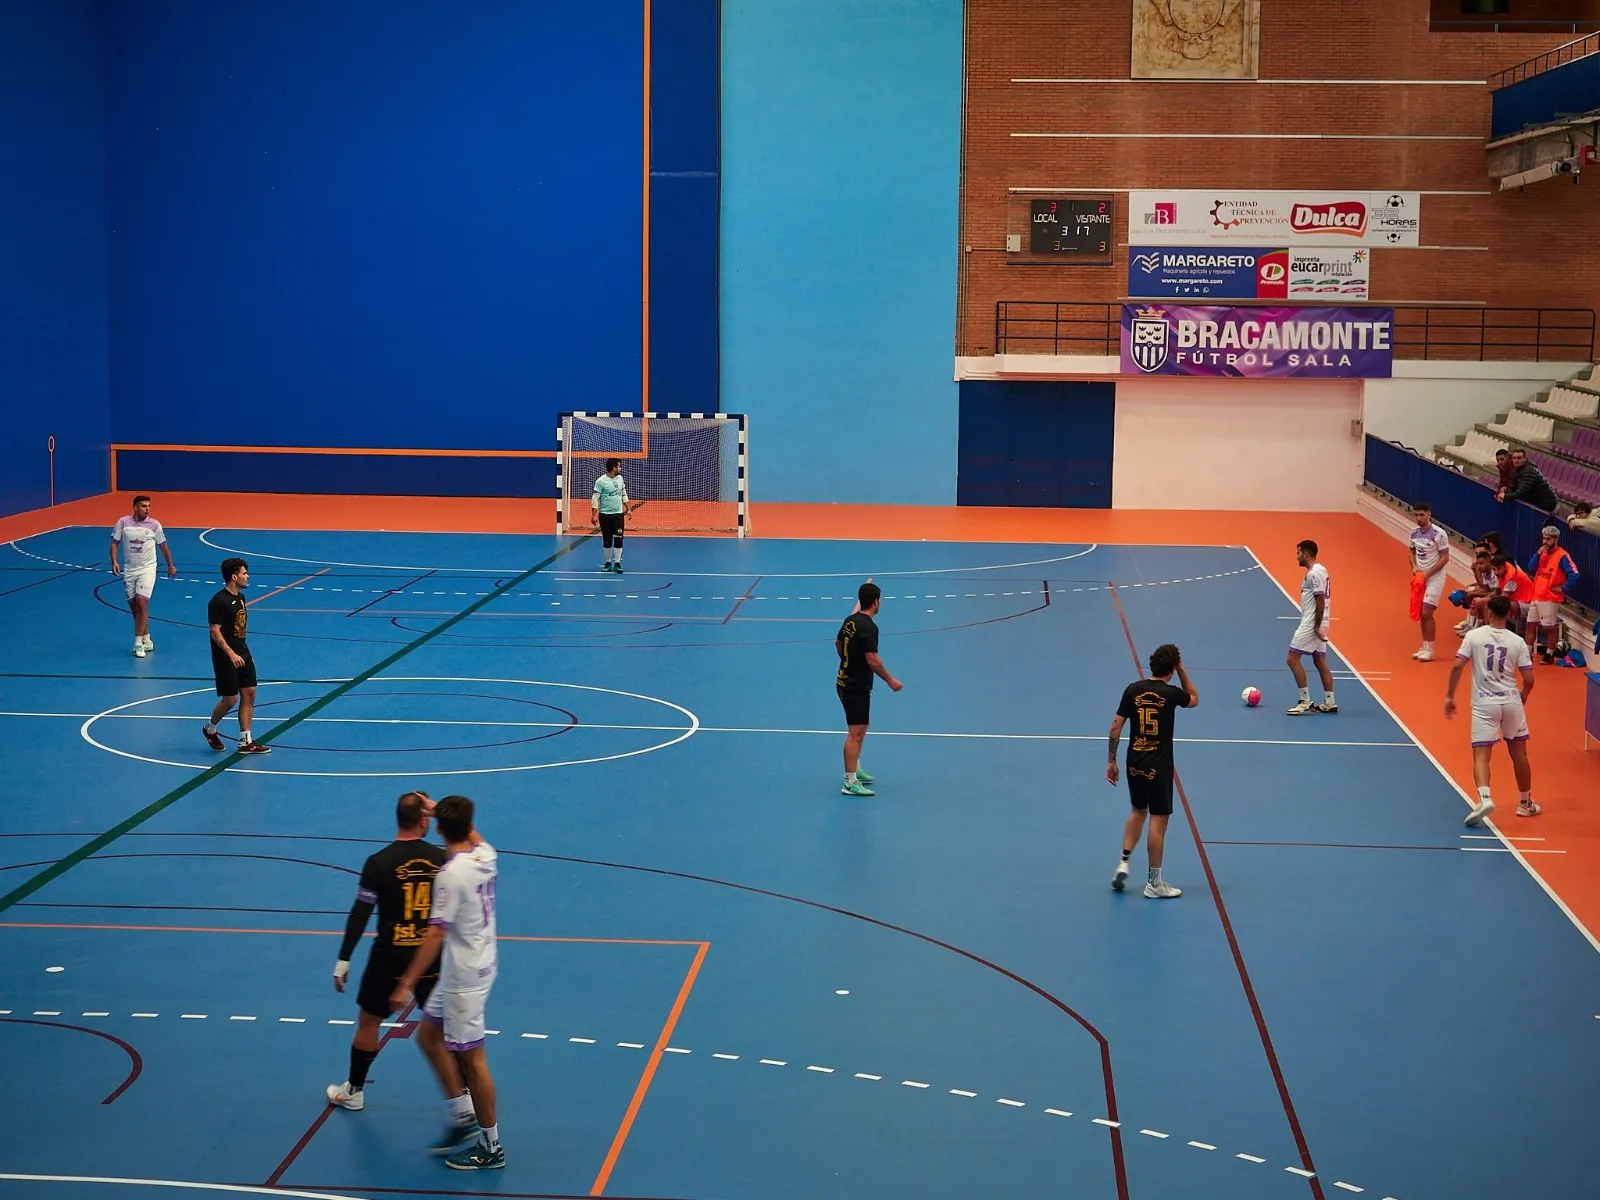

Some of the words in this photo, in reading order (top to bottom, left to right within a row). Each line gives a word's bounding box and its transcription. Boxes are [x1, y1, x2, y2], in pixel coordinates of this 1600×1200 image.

[1050, 202, 1057, 213] 3
[1098, 202, 1106, 213] 2
[1231, 207, 1264, 216] TÉCNICA
[1371, 207, 1400, 220] 32
[1033, 213, 1058, 223] LOCAL
[1076, 214, 1111, 224] VISITANTE
[1240, 216, 1289, 224] PREVENCIÓN
[1294, 206, 1361, 227] Dulca
[1053, 240, 1060, 251] 3
[1099, 241, 1106, 251] 3
[1163, 254, 1256, 267] MARGARETO
[1291, 260, 1353, 276] eucarprint
[1176, 320, 1391, 351] BRACAMONTE
[1176, 350, 1275, 367] FÚTBOL
[1287, 353, 1352, 367] SALA
[1483, 643, 1508, 673] 11
[1137, 708, 1159, 735] 15
[401, 881, 431, 921] 14
